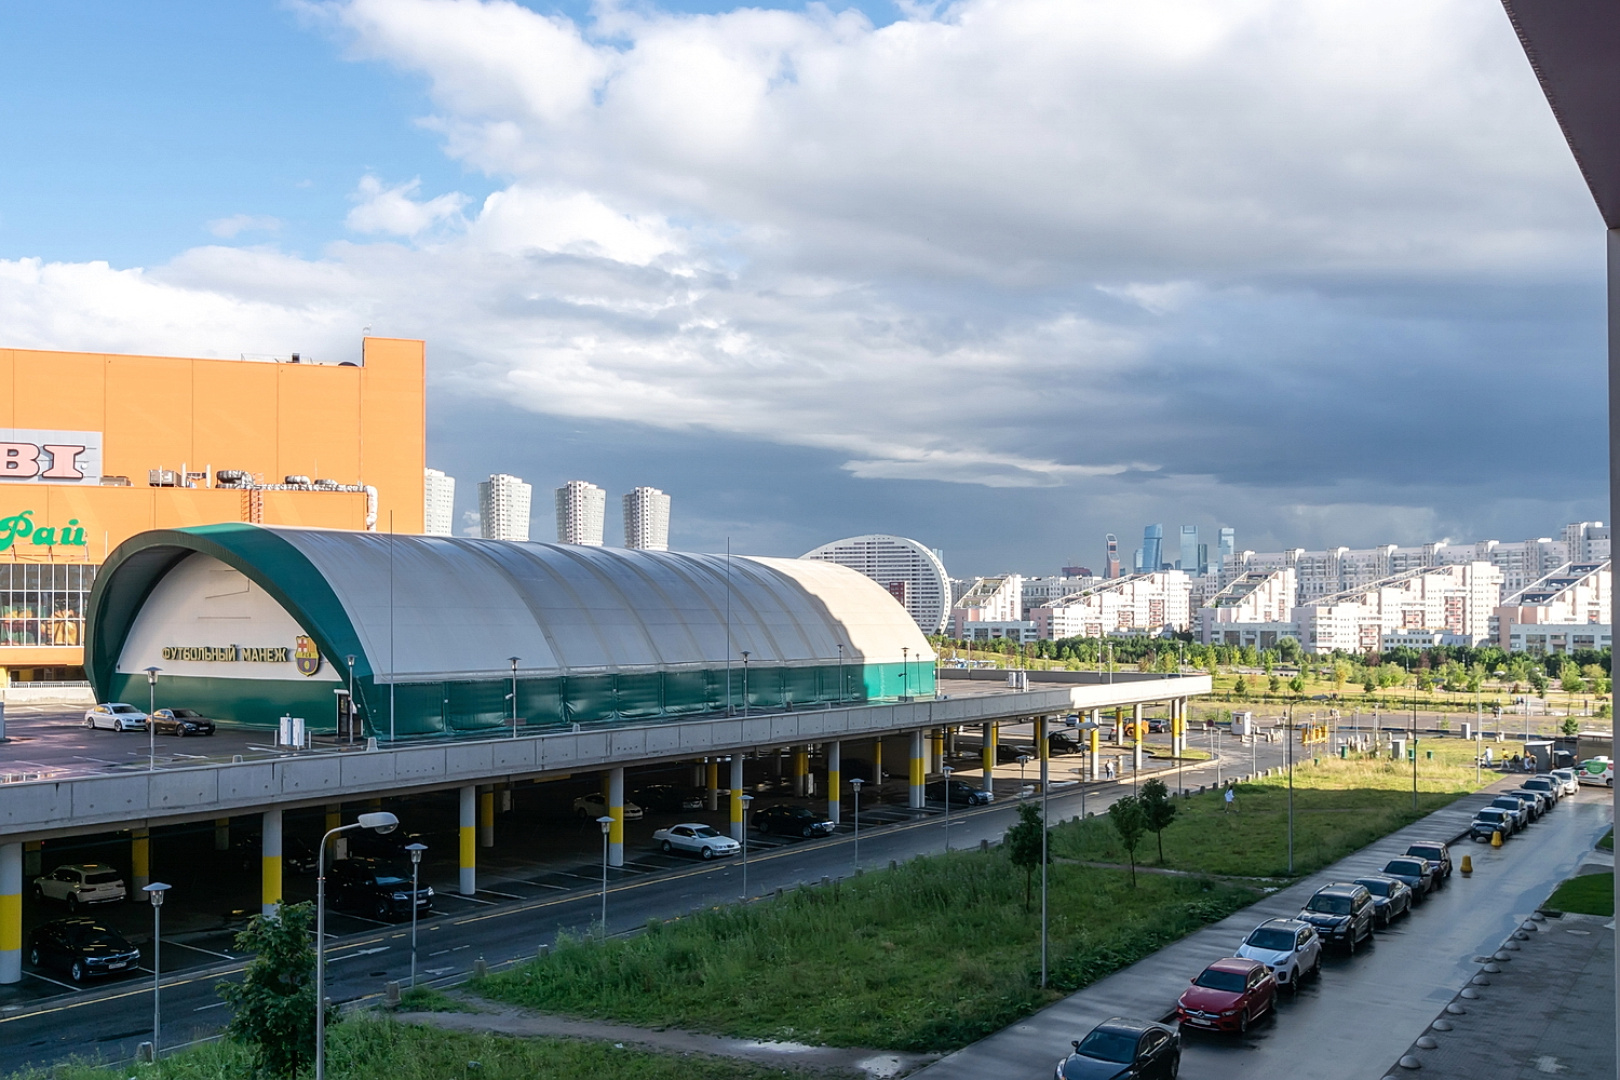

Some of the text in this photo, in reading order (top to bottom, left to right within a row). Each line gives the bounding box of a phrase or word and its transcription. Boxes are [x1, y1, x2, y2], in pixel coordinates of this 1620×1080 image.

[0, 510, 87, 551] Рай
[162, 644, 287, 662] ФУТБОЛЬНЫЙ МАНЕЖ
